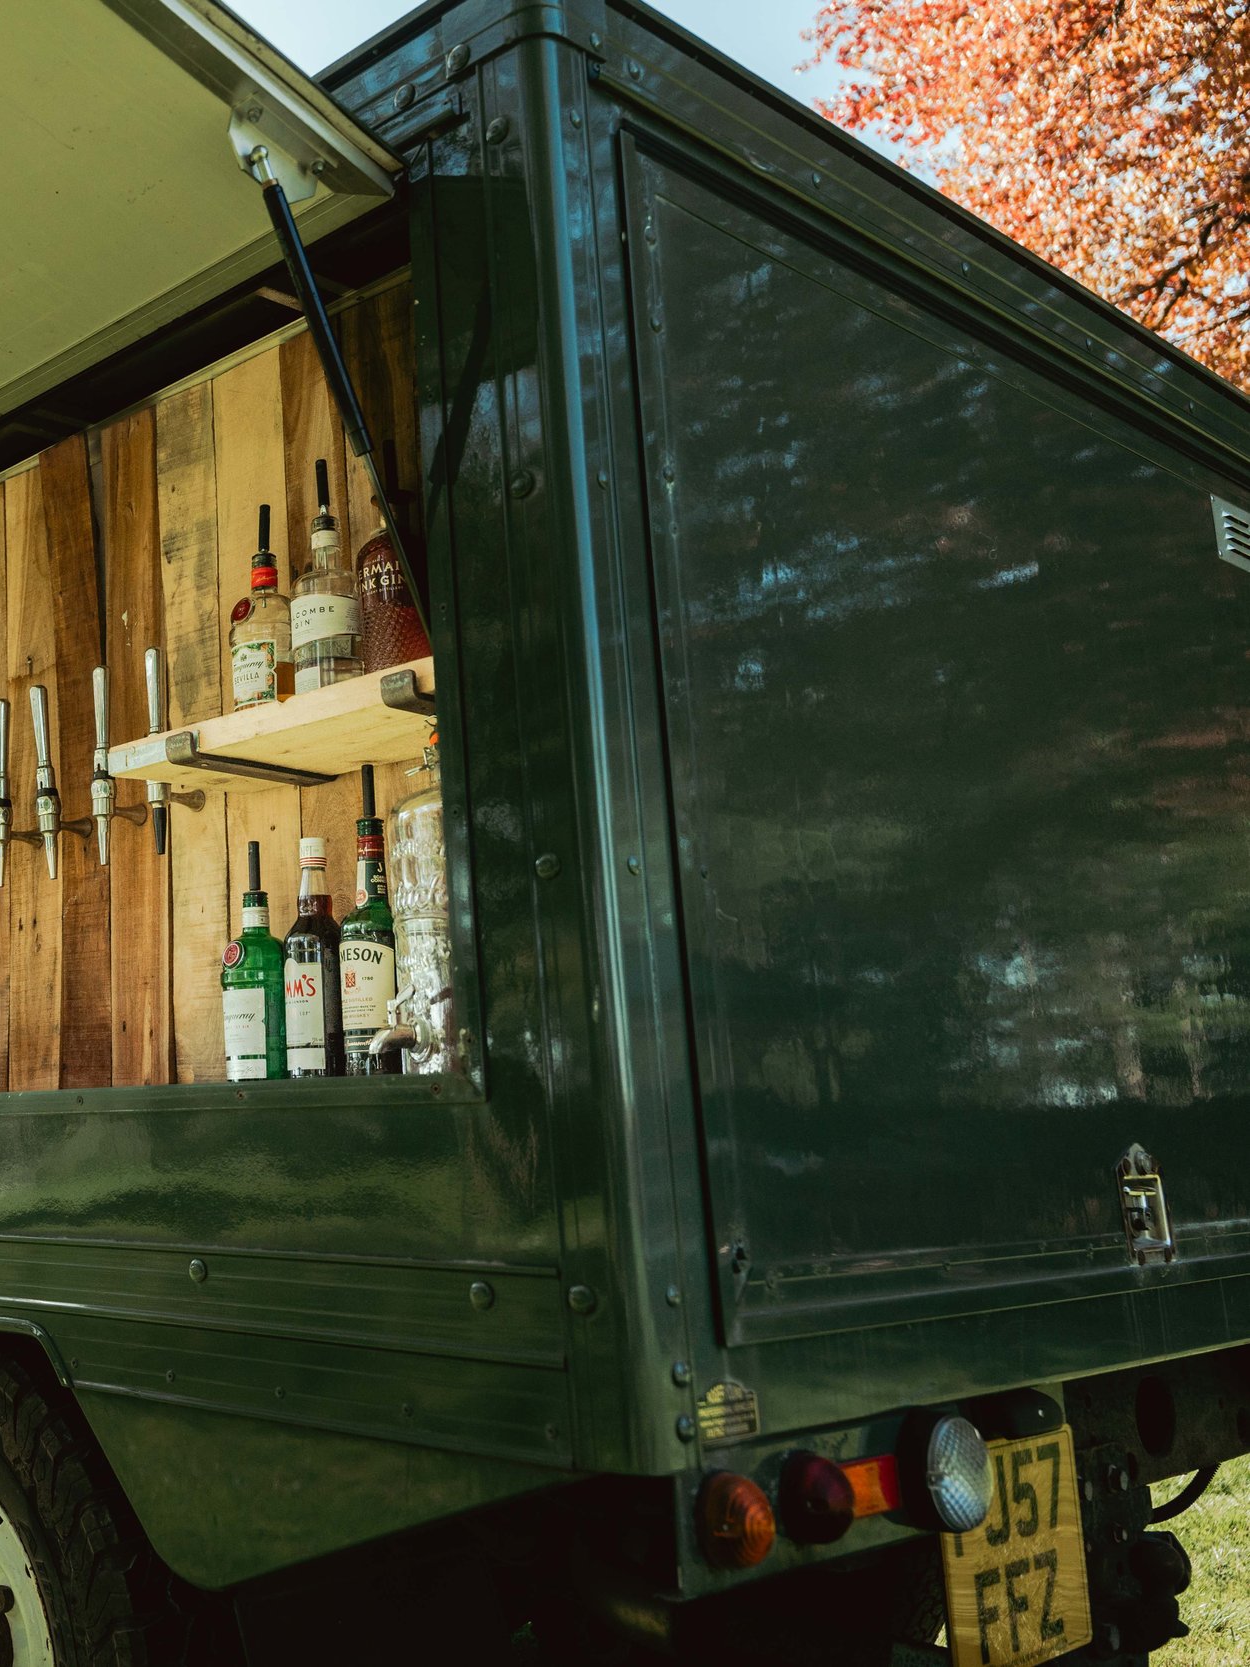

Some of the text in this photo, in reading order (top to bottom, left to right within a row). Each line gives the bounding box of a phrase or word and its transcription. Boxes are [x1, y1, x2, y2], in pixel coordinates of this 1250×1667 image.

[359, 560, 400, 581] ERMAI
[292, 605, 334, 621] COMBE
[294, 619, 310, 630] GIN
[234, 671, 260, 685] SEVILLA
[340, 947, 383, 965] MESON
[286, 973, 316, 998] MM'S
[953, 1441, 1061, 1559] J57
[973, 1548, 1065, 1665] FFZ
